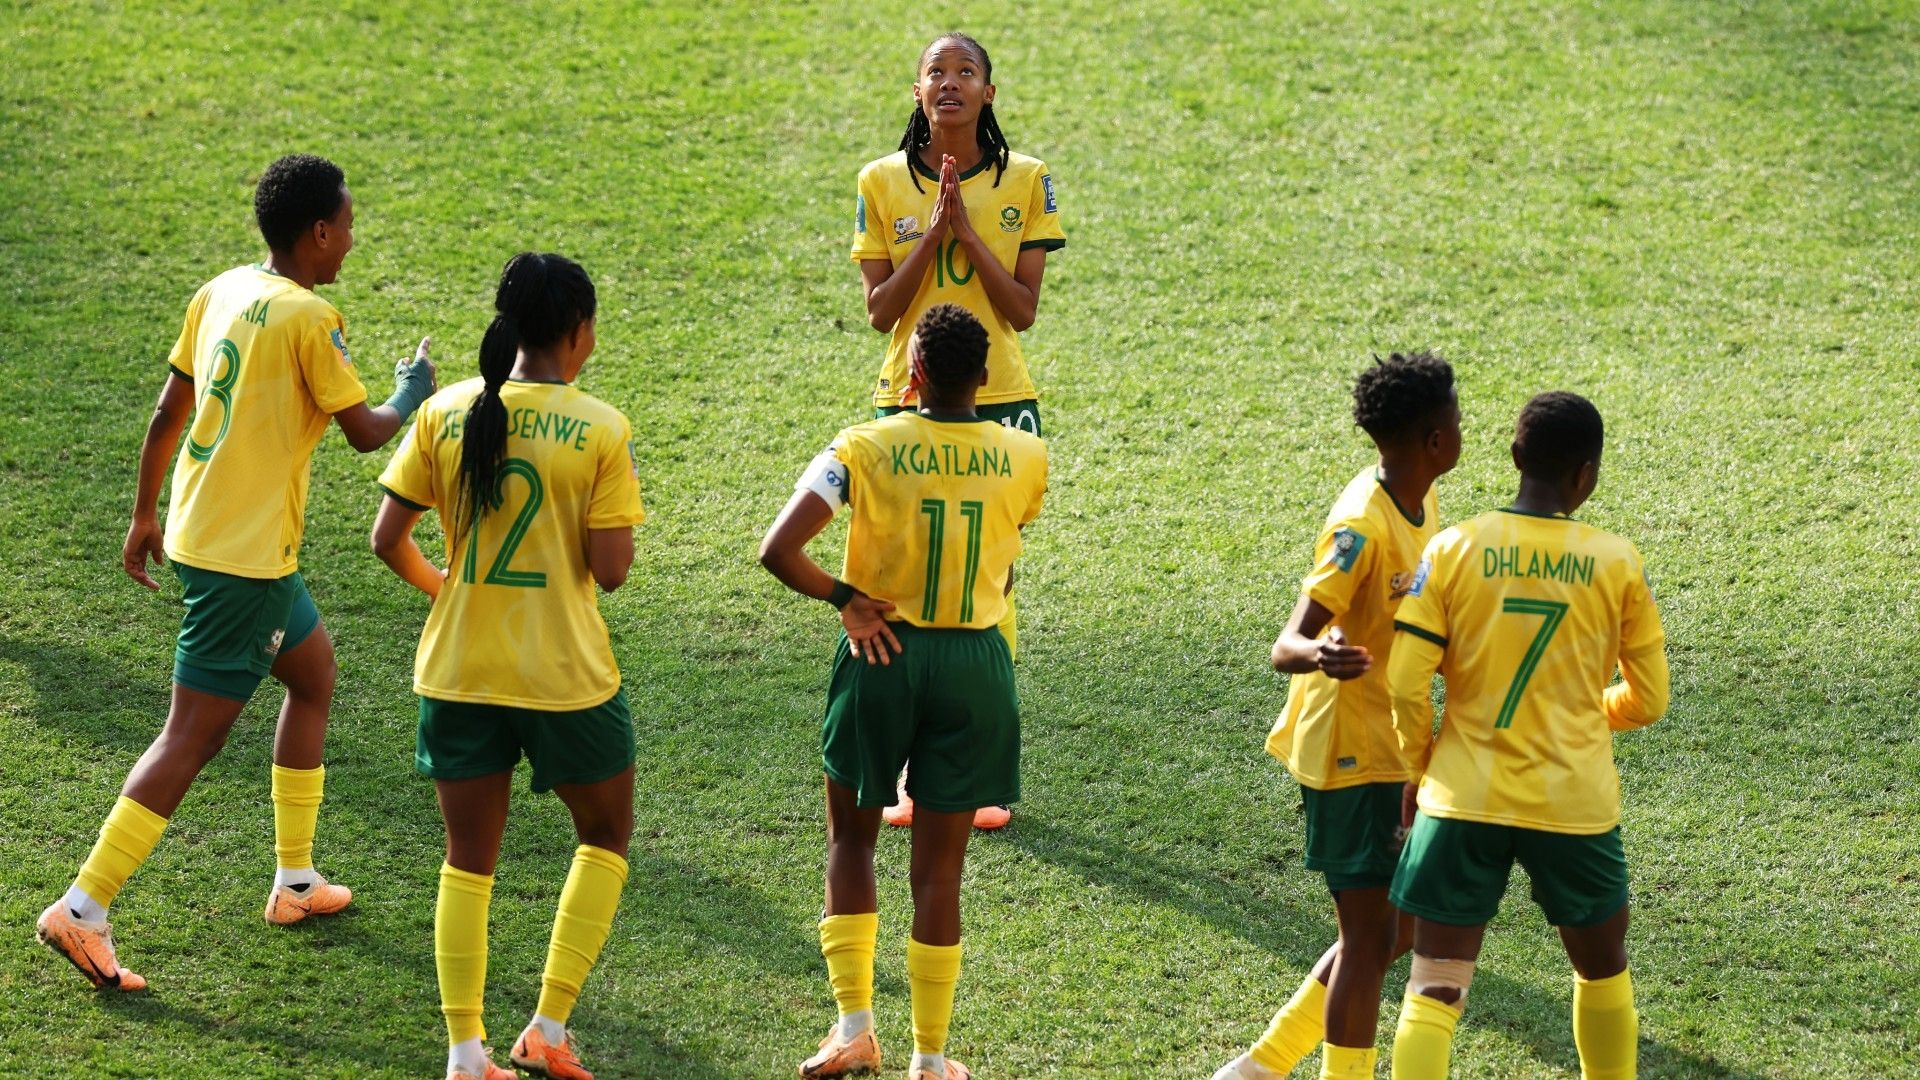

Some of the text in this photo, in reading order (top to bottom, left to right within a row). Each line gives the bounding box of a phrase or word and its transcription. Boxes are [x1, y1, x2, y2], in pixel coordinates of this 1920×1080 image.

[936, 238, 976, 288] 10
[187, 338, 241, 462] 8
[441, 408, 591, 451] SESENWE
[892, 443, 1012, 478] KGATLANA
[921, 499, 983, 623] 11
[1483, 546, 1595, 586] DHLAMINI
[1494, 597, 1570, 729] 7
